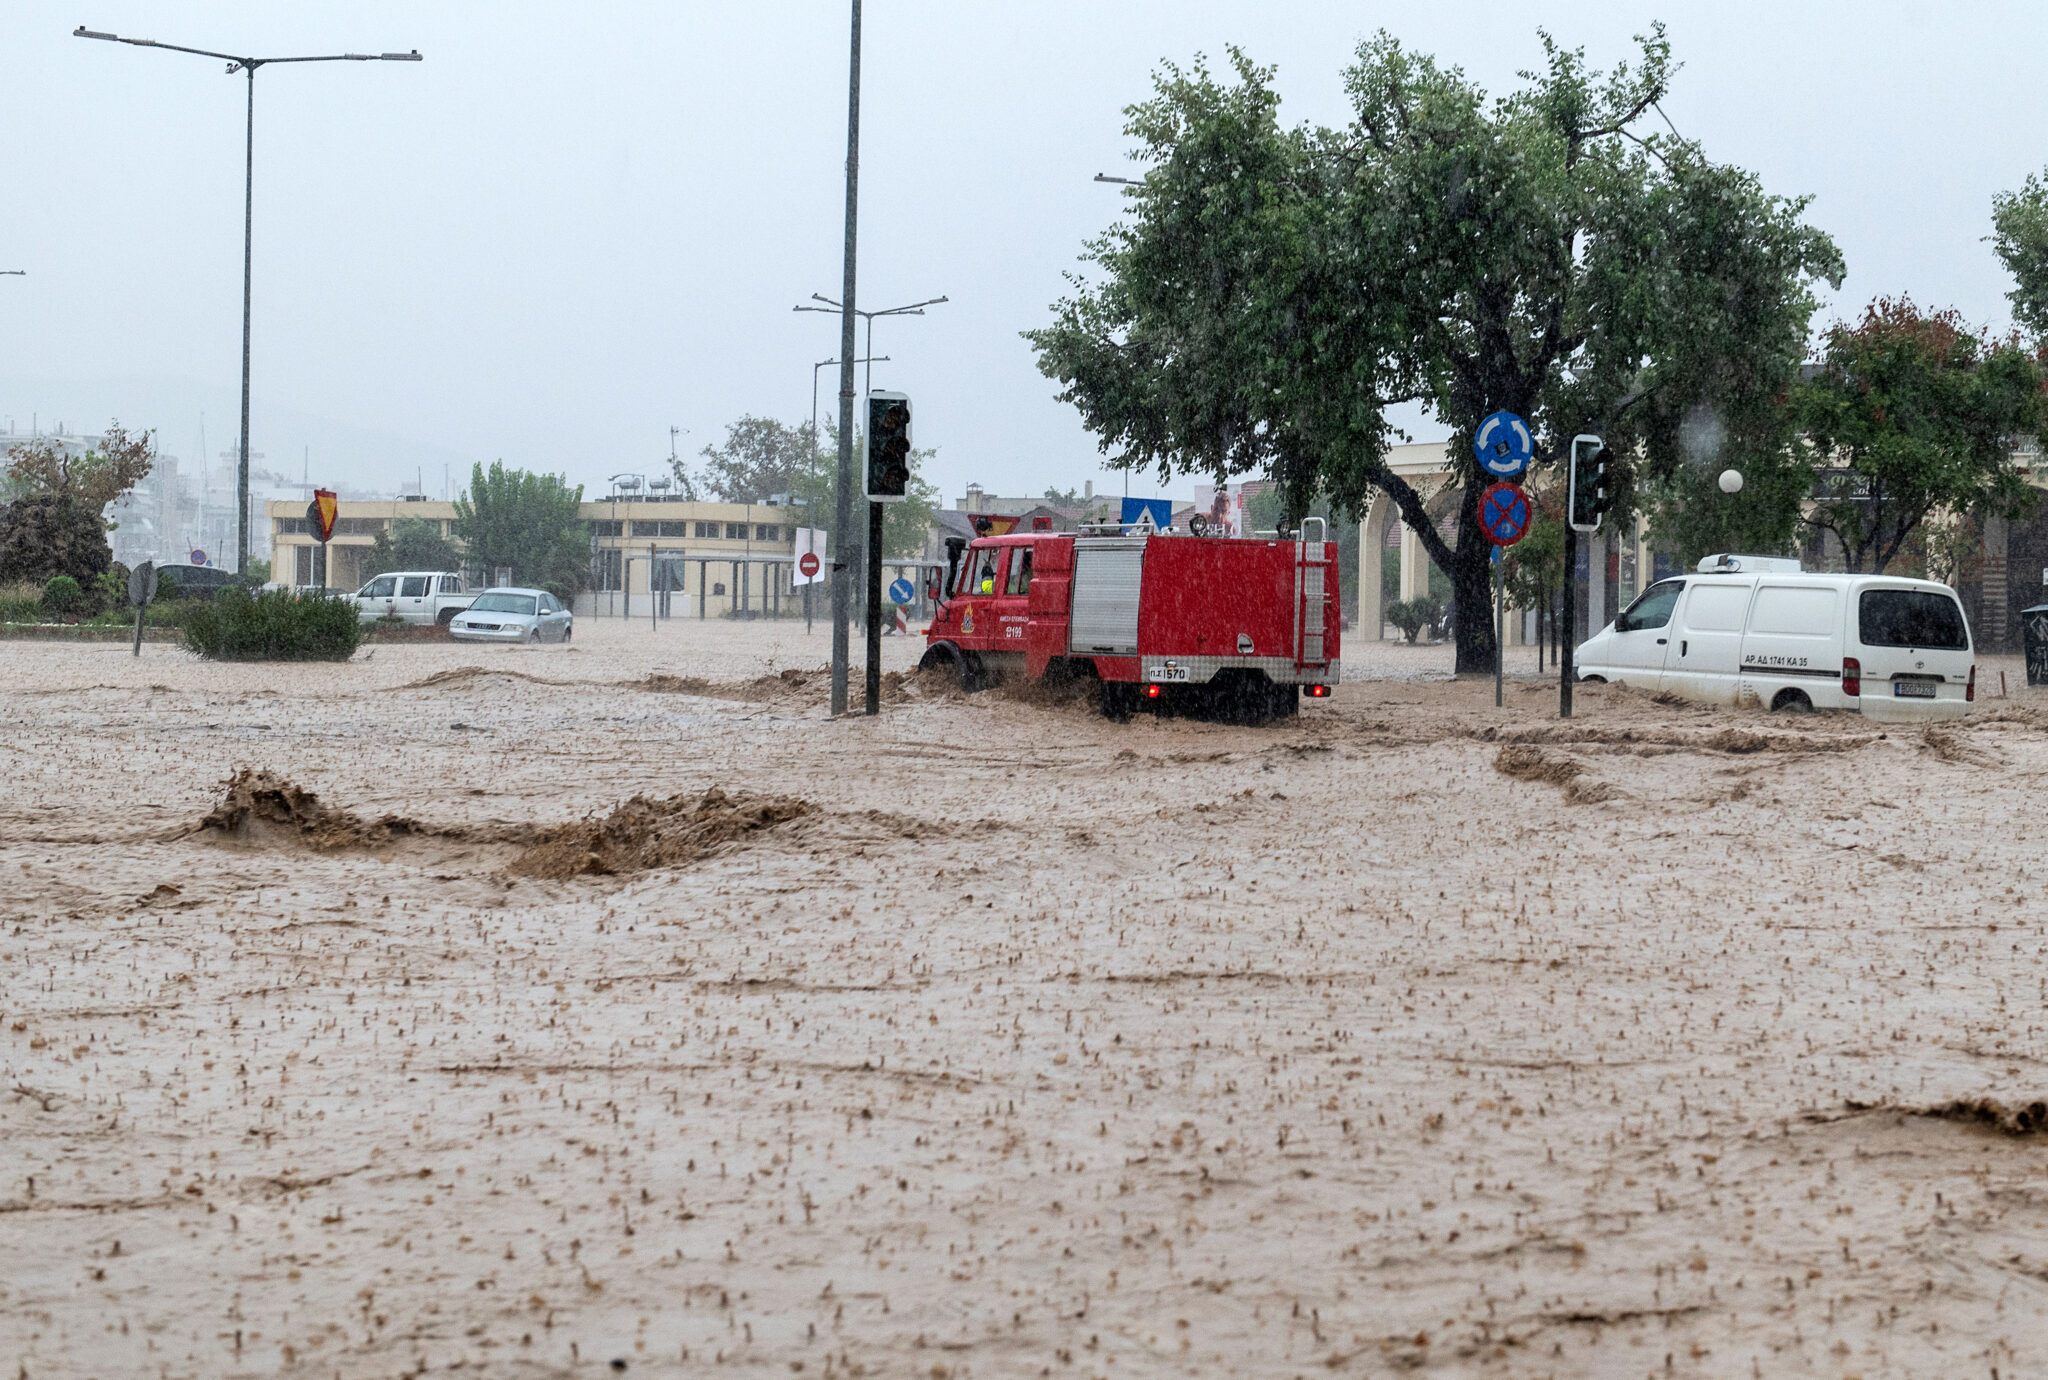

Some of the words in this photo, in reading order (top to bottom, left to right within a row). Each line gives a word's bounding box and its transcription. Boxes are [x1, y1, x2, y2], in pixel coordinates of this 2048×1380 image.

[1769, 656, 1785, 666] 1741
[1799, 657, 1808, 667] 35
[1164, 669, 1185, 679] 1570
